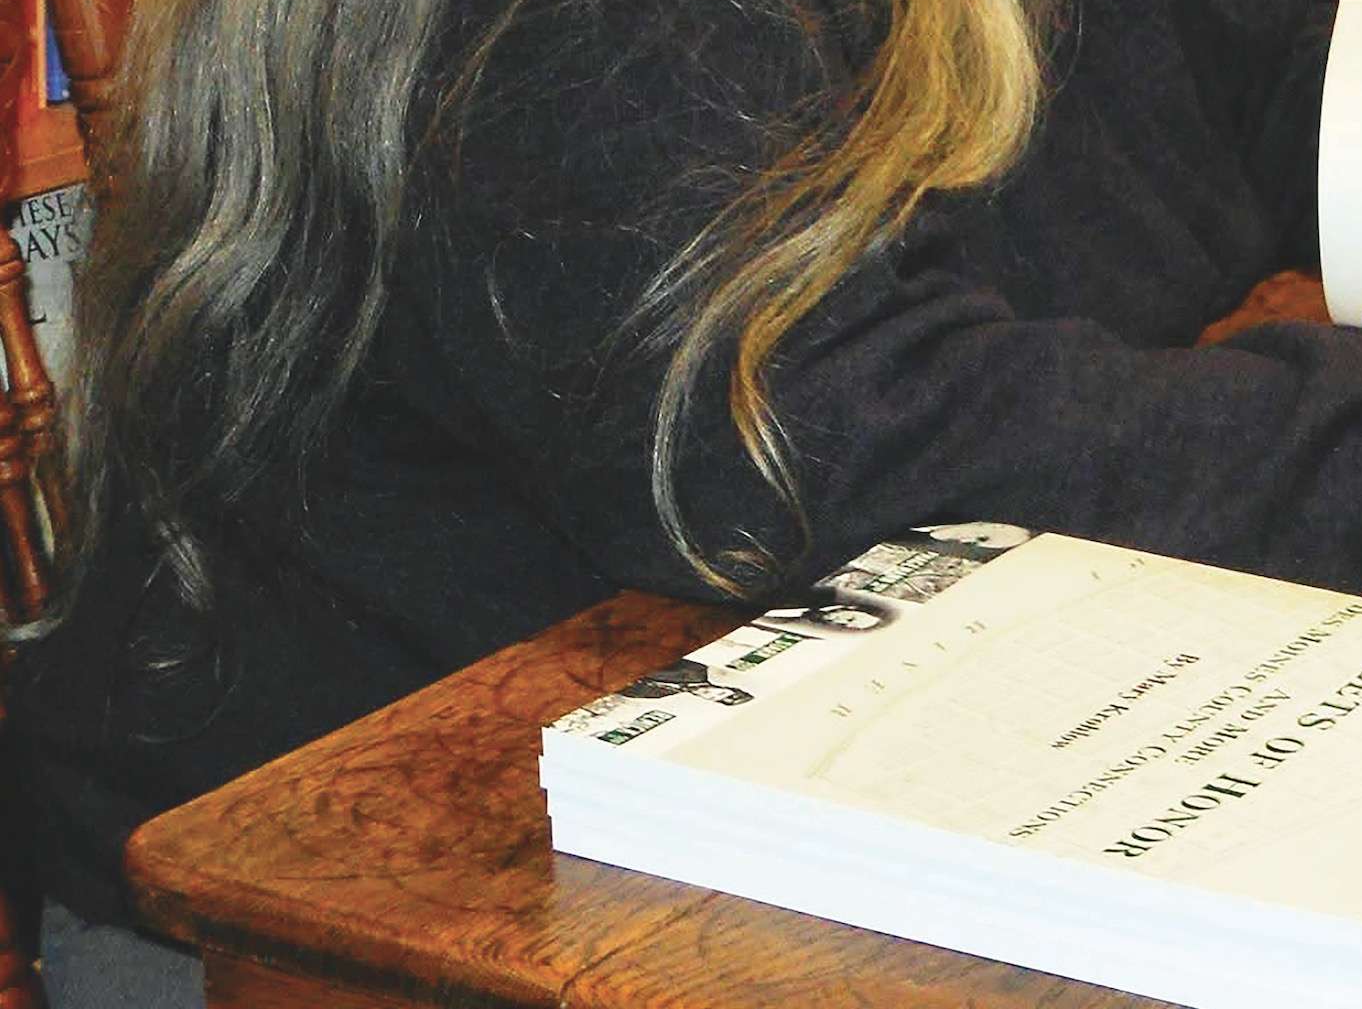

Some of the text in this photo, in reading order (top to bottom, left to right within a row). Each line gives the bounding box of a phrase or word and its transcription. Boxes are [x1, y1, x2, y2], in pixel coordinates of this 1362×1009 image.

[27, 224, 81, 263] AYS
[1164, 653, 1200, 668] By
[1244, 628, 1332, 683] MOINES
[1118, 671, 1177, 701] Mary
[1162, 685, 1252, 743] COUNTY
[1174, 689, 1291, 765] AND MORE
[1250, 737, 1305, 770] OF
[1009, 745, 1168, 838] CONNECTIONS
[1102, 773, 1262, 857] HONOR
